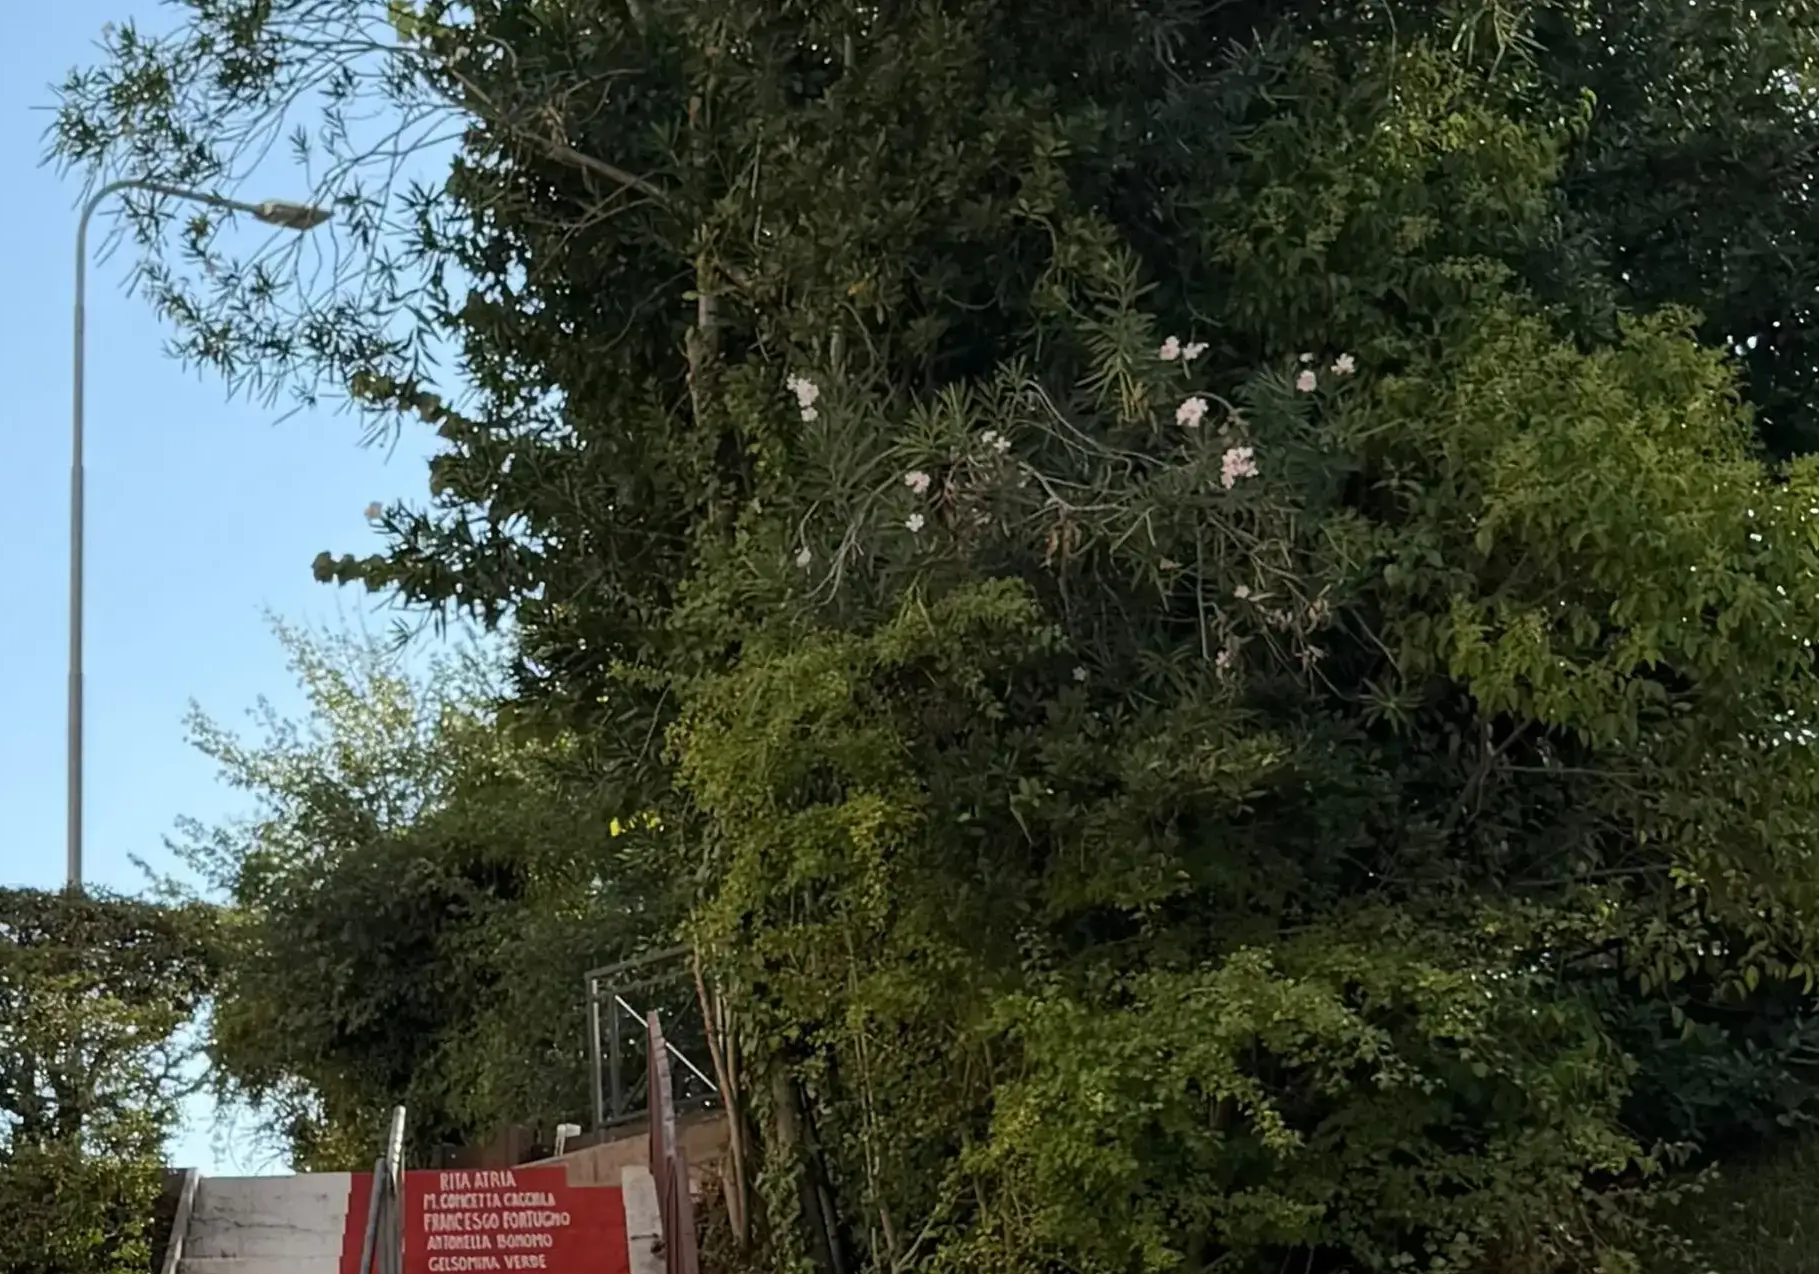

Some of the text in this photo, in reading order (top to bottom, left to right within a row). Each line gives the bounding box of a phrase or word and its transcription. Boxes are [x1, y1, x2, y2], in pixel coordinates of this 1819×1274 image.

[440, 1170, 517, 1191] RITA ATRIA
[424, 1211, 571, 1232] FRANCESCO FORTUGNO
[504, 1254, 547, 1270] VERDE
